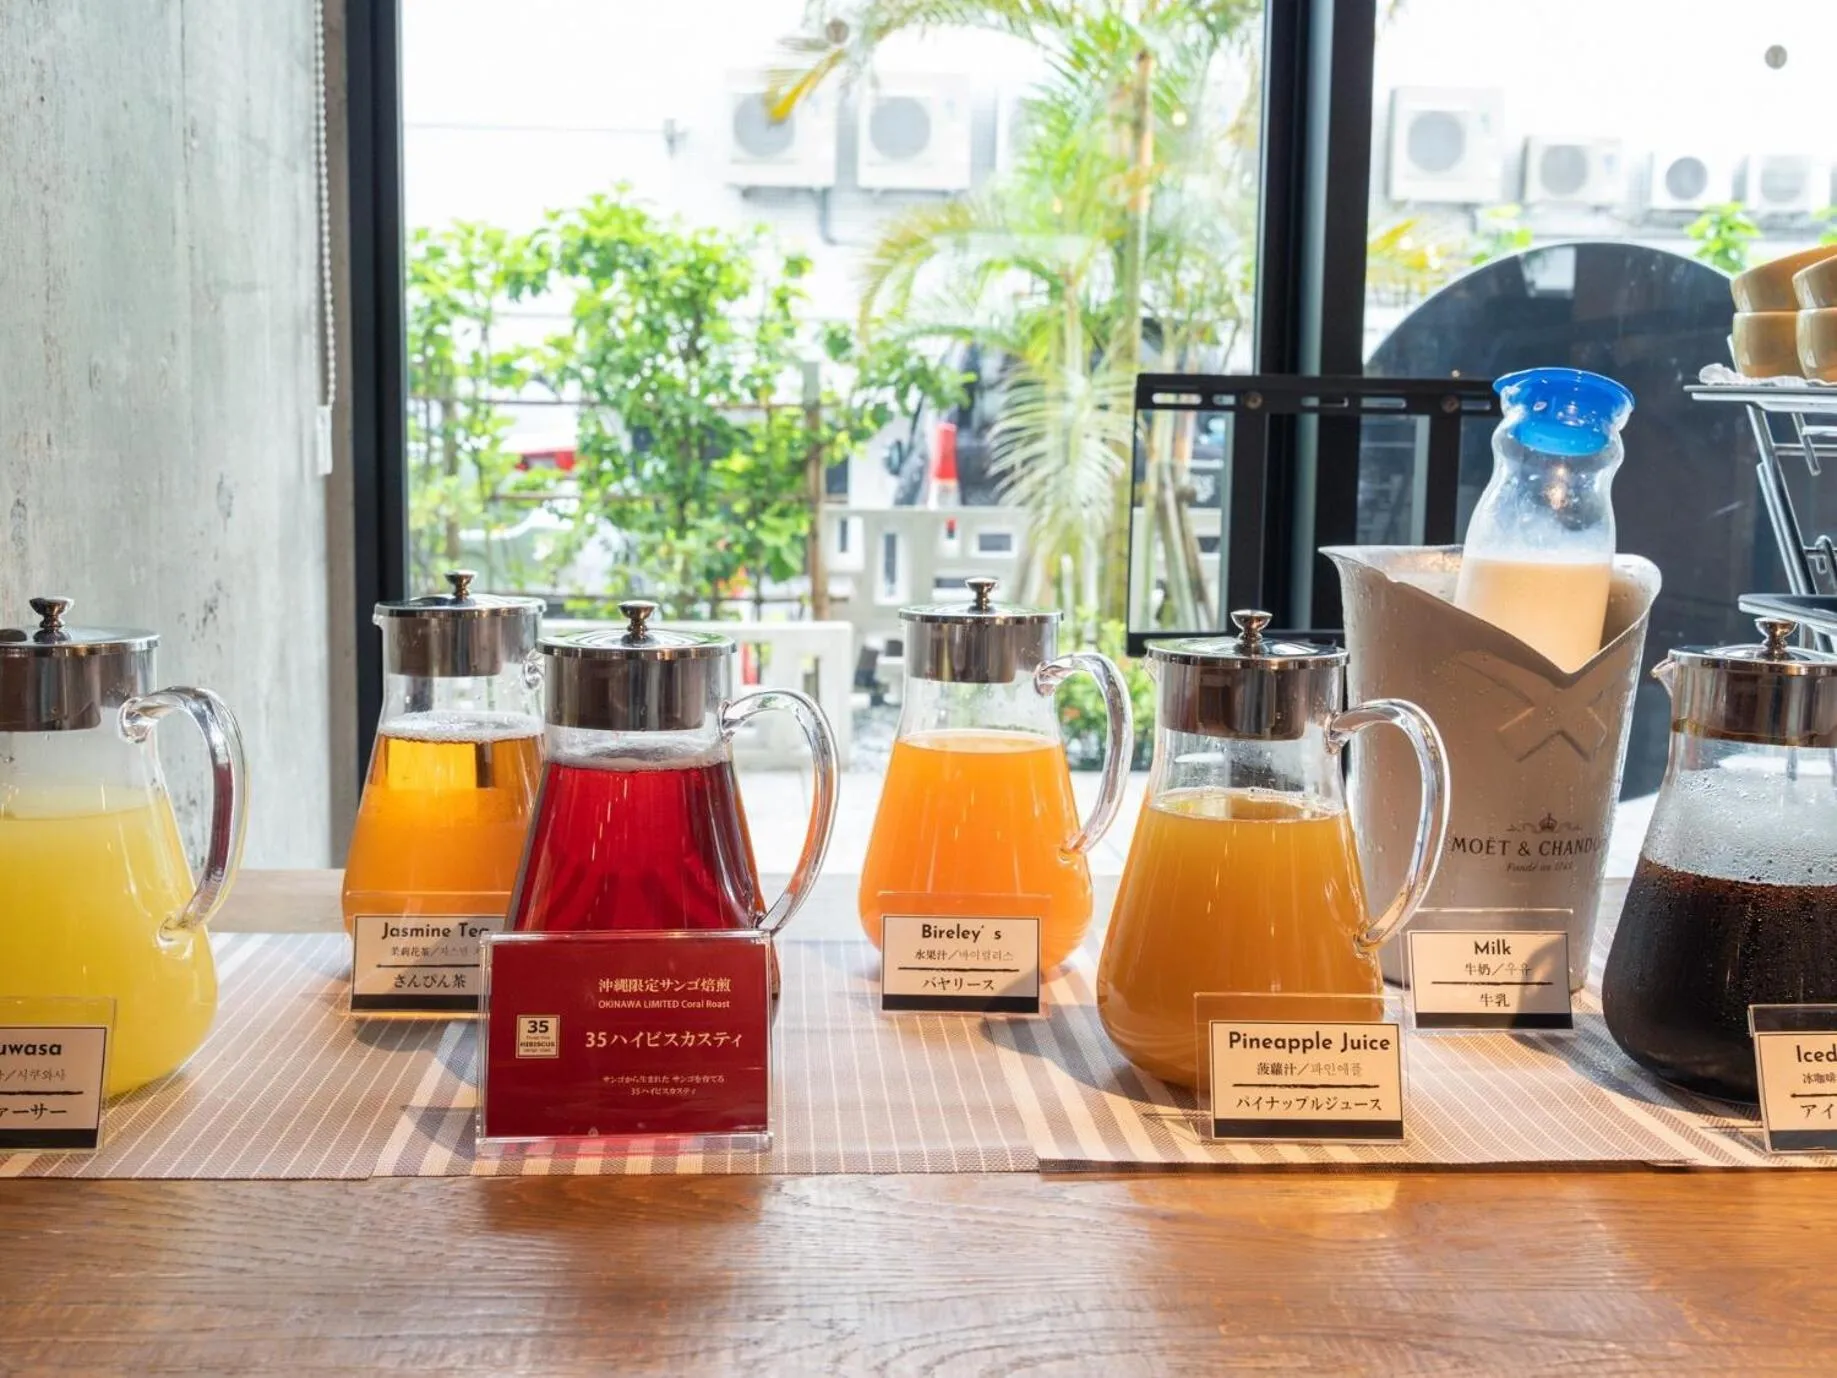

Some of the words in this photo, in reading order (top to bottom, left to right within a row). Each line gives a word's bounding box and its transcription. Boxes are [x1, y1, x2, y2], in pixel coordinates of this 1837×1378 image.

[1451, 836, 1511, 856] MOËT
[1518, 841, 1532, 857] &
[382, 922, 452, 940] Jasmine
[1474, 938, 1512, 956] Milk
[598, 977, 732, 993] 沖縄限定サンゴ焙煎
[598, 1000, 642, 1009] OKINAWA
[643, 1000, 679, 1009] LIMITED
[681, 999, 704, 1009] Coral
[705, 999, 730, 1009] Roast
[1479, 993, 1511, 1008] 牛乳
[527, 1020, 549, 1034] 35
[1229, 1031, 1333, 1054] Pineapple
[1340, 1032, 1391, 1053] Juice
[1796, 1043, 1837, 1063] Iced
